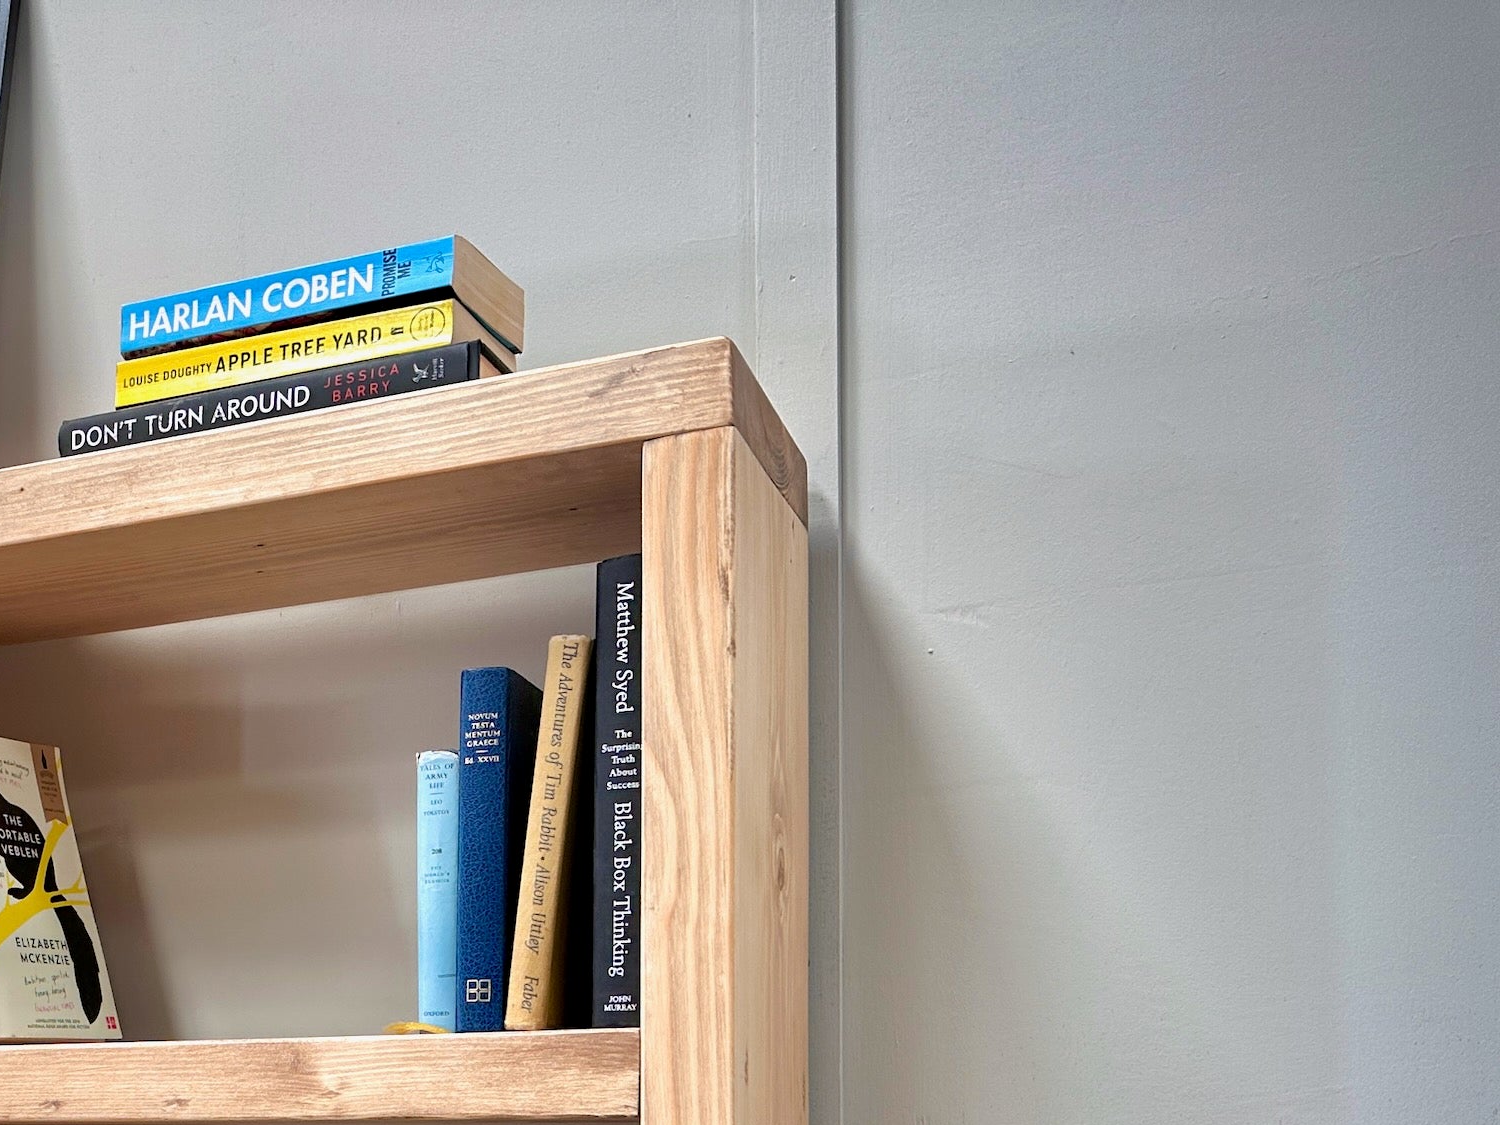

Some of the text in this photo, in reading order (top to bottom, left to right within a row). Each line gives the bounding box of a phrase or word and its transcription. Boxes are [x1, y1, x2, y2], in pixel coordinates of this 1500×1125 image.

[381, 248, 397, 297] PROMISE
[398, 260, 412, 280] ME
[128, 263, 374, 342] HARLAN COBEN
[123, 372, 160, 389] LOUISE
[163, 361, 213, 381] DOUGHTY
[215, 347, 273, 374] APPLE
[279, 336, 326, 361] TREE
[332, 326, 382, 350] YARD
[324, 363, 399, 389] JESSICA
[332, 380, 391, 402] BARRY
[70, 385, 311, 451] DON'T TURN AROUND
[612, 581, 636, 714] Matthew Syed
[468, 712, 499, 721] NOVUM
[471, 721, 495, 730] TESTA
[464, 730, 501, 739] MENTUM
[614, 729, 633, 739] The
[466, 738, 499, 748] GRAECE
[611, 754, 636, 764] Truth
[420, 762, 454, 772] TALES OF
[609, 768, 638, 778] About
[425, 772, 448, 780] ARMY
[606, 781, 640, 791] Success
[2, 813, 23, 827] THE
[520, 642, 579, 1014] The Adventures of Tim Rabbit Alison Uttley Faber
[0, 843, 39, 858] VEBLEN
[608, 801, 634, 978] Black Box Thinking
[15, 937, 68, 950] ELIZABETH
[19, 952, 71, 966] MCKENZIE
[608, 995, 632, 1004] JOHN
[603, 1003, 637, 1012] MURRAY
